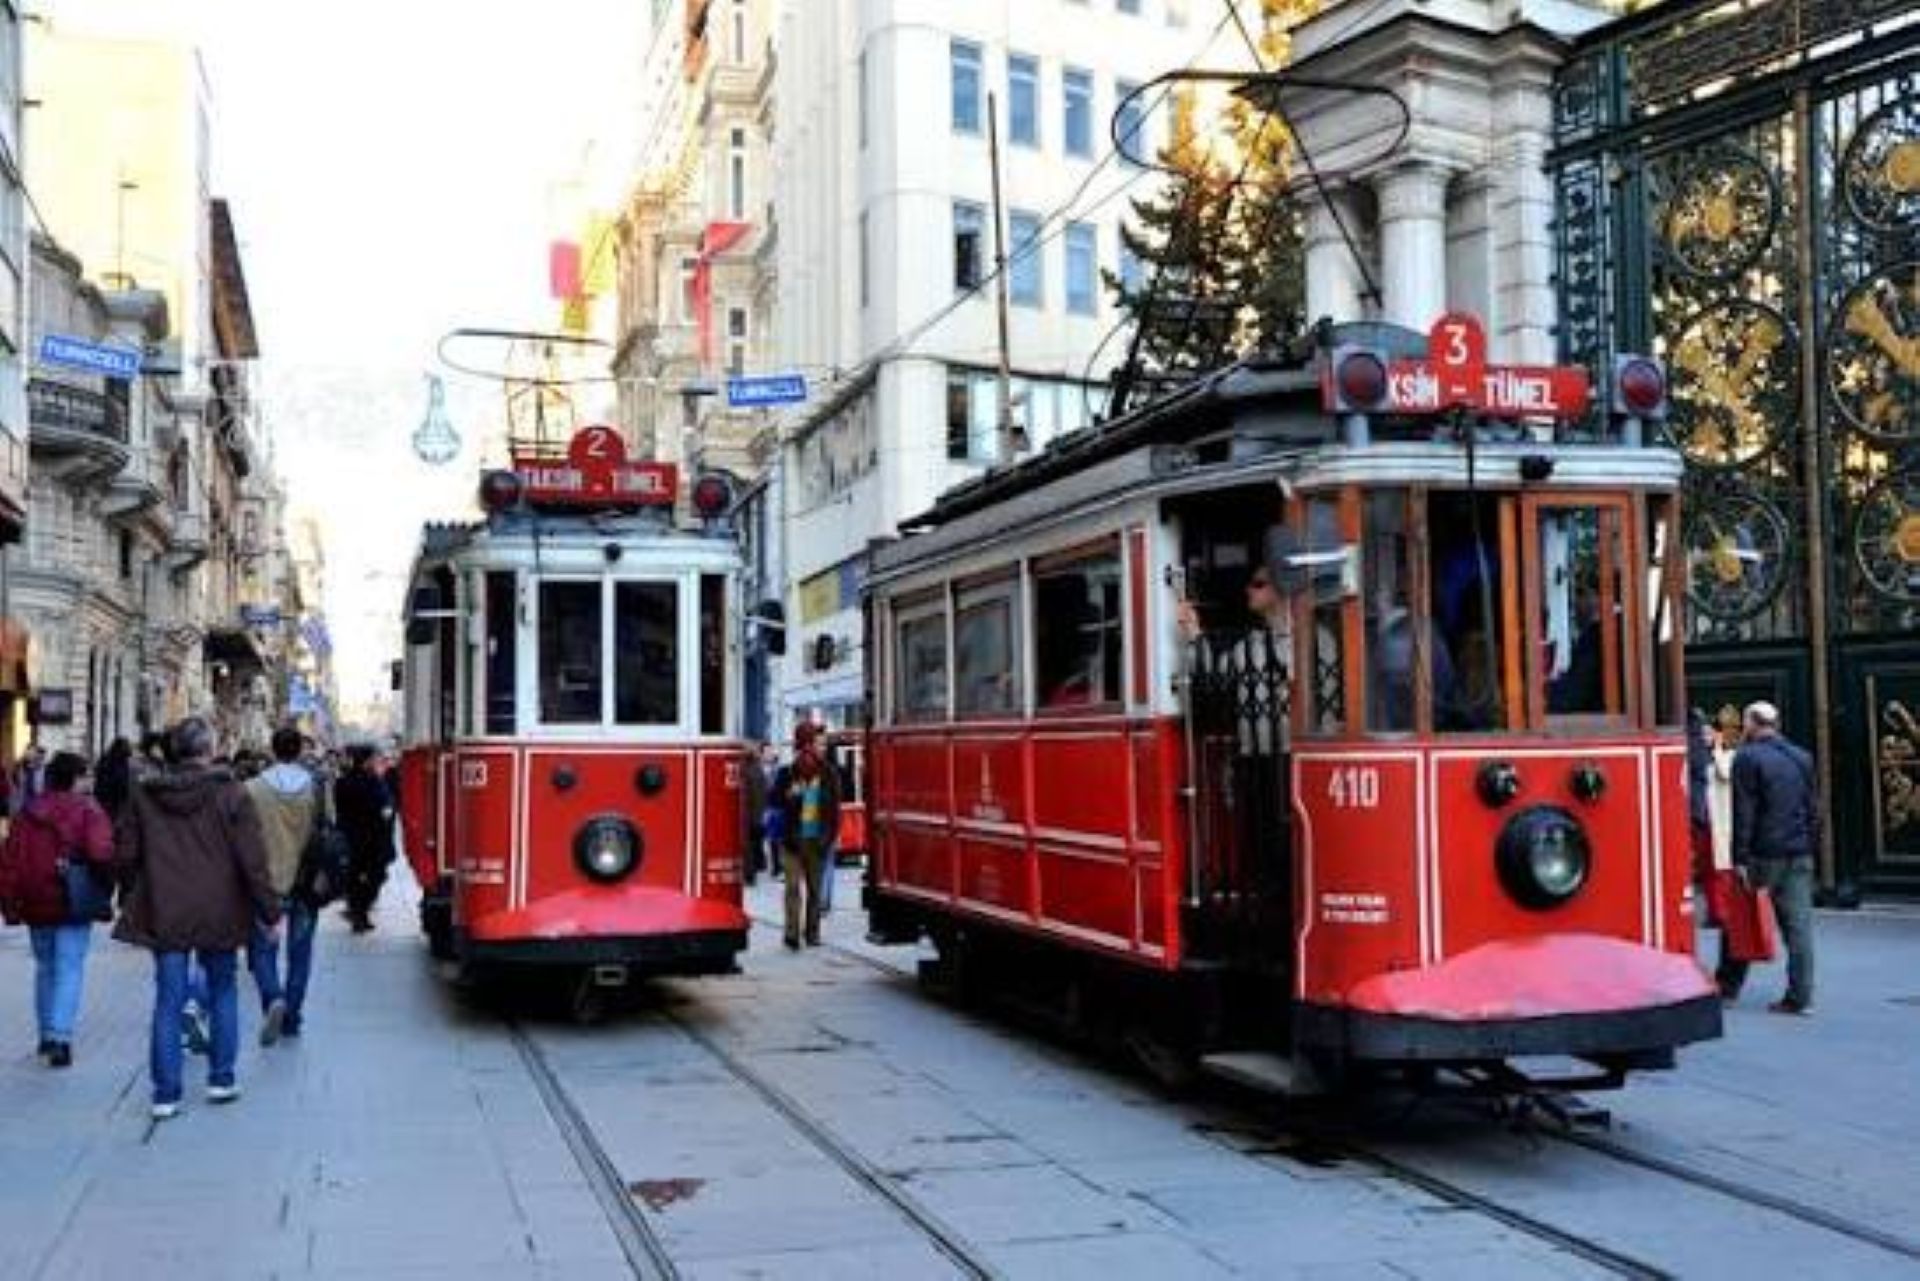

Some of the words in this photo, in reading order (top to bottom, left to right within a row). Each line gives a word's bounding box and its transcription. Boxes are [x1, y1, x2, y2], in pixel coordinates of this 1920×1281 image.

[1443, 323, 1468, 365] 3
[1387, 366, 1440, 406] KSİM
[1483, 368, 1558, 411] TÜNEL
[587, 430, 608, 457] 2
[1328, 765, 1380, 808] 410
